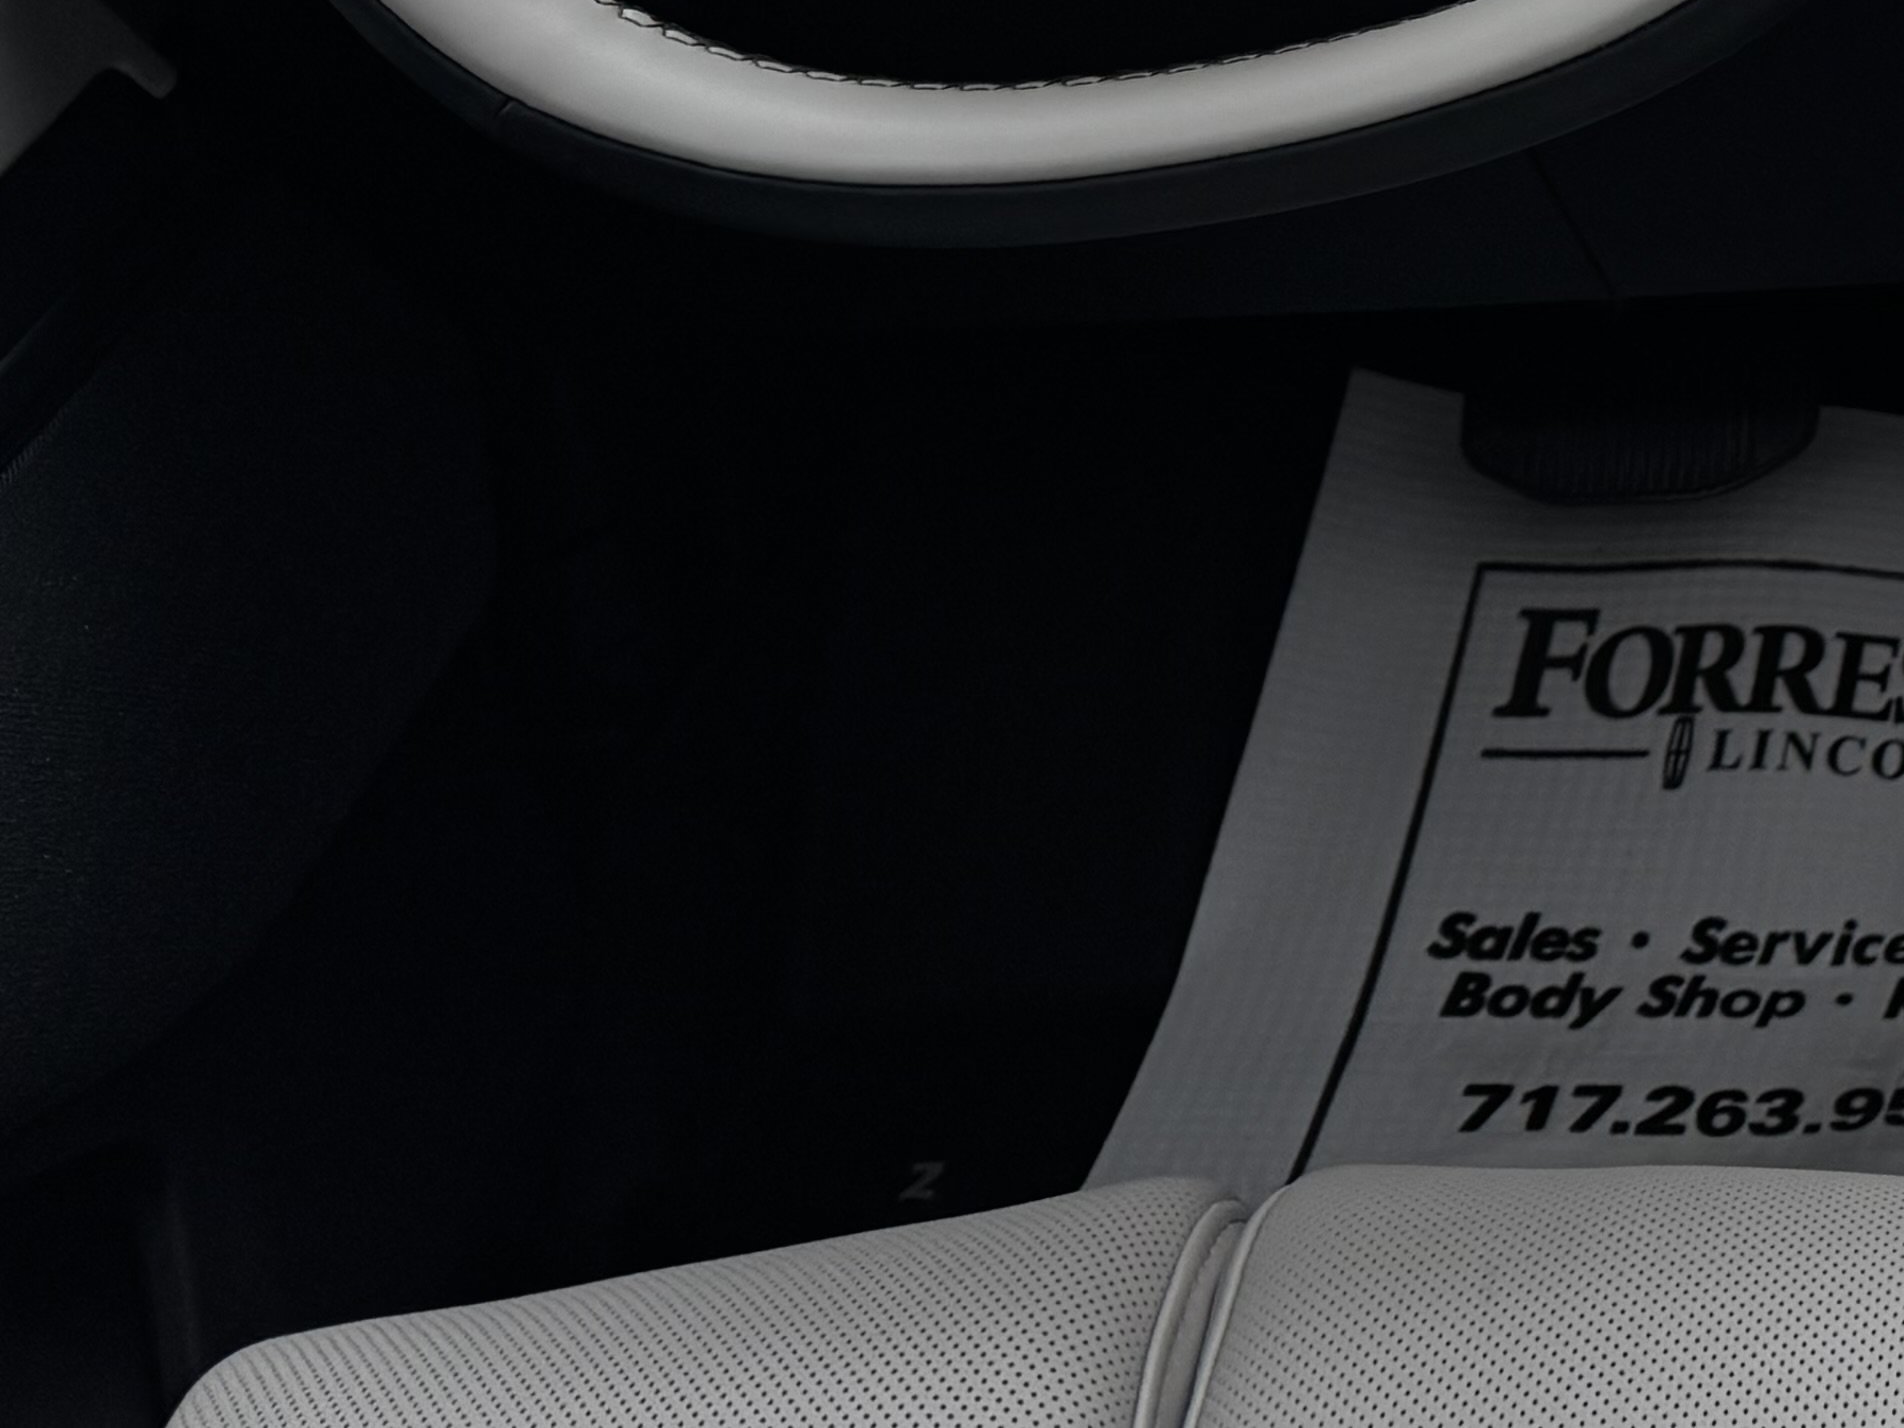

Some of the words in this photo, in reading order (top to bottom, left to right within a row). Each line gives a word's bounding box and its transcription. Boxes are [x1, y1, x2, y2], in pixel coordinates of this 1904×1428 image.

[1427, 911, 1602, 962] Sales
[1440, 972, 1623, 1031] Body
[1637, 976, 1807, 1029] Shop
